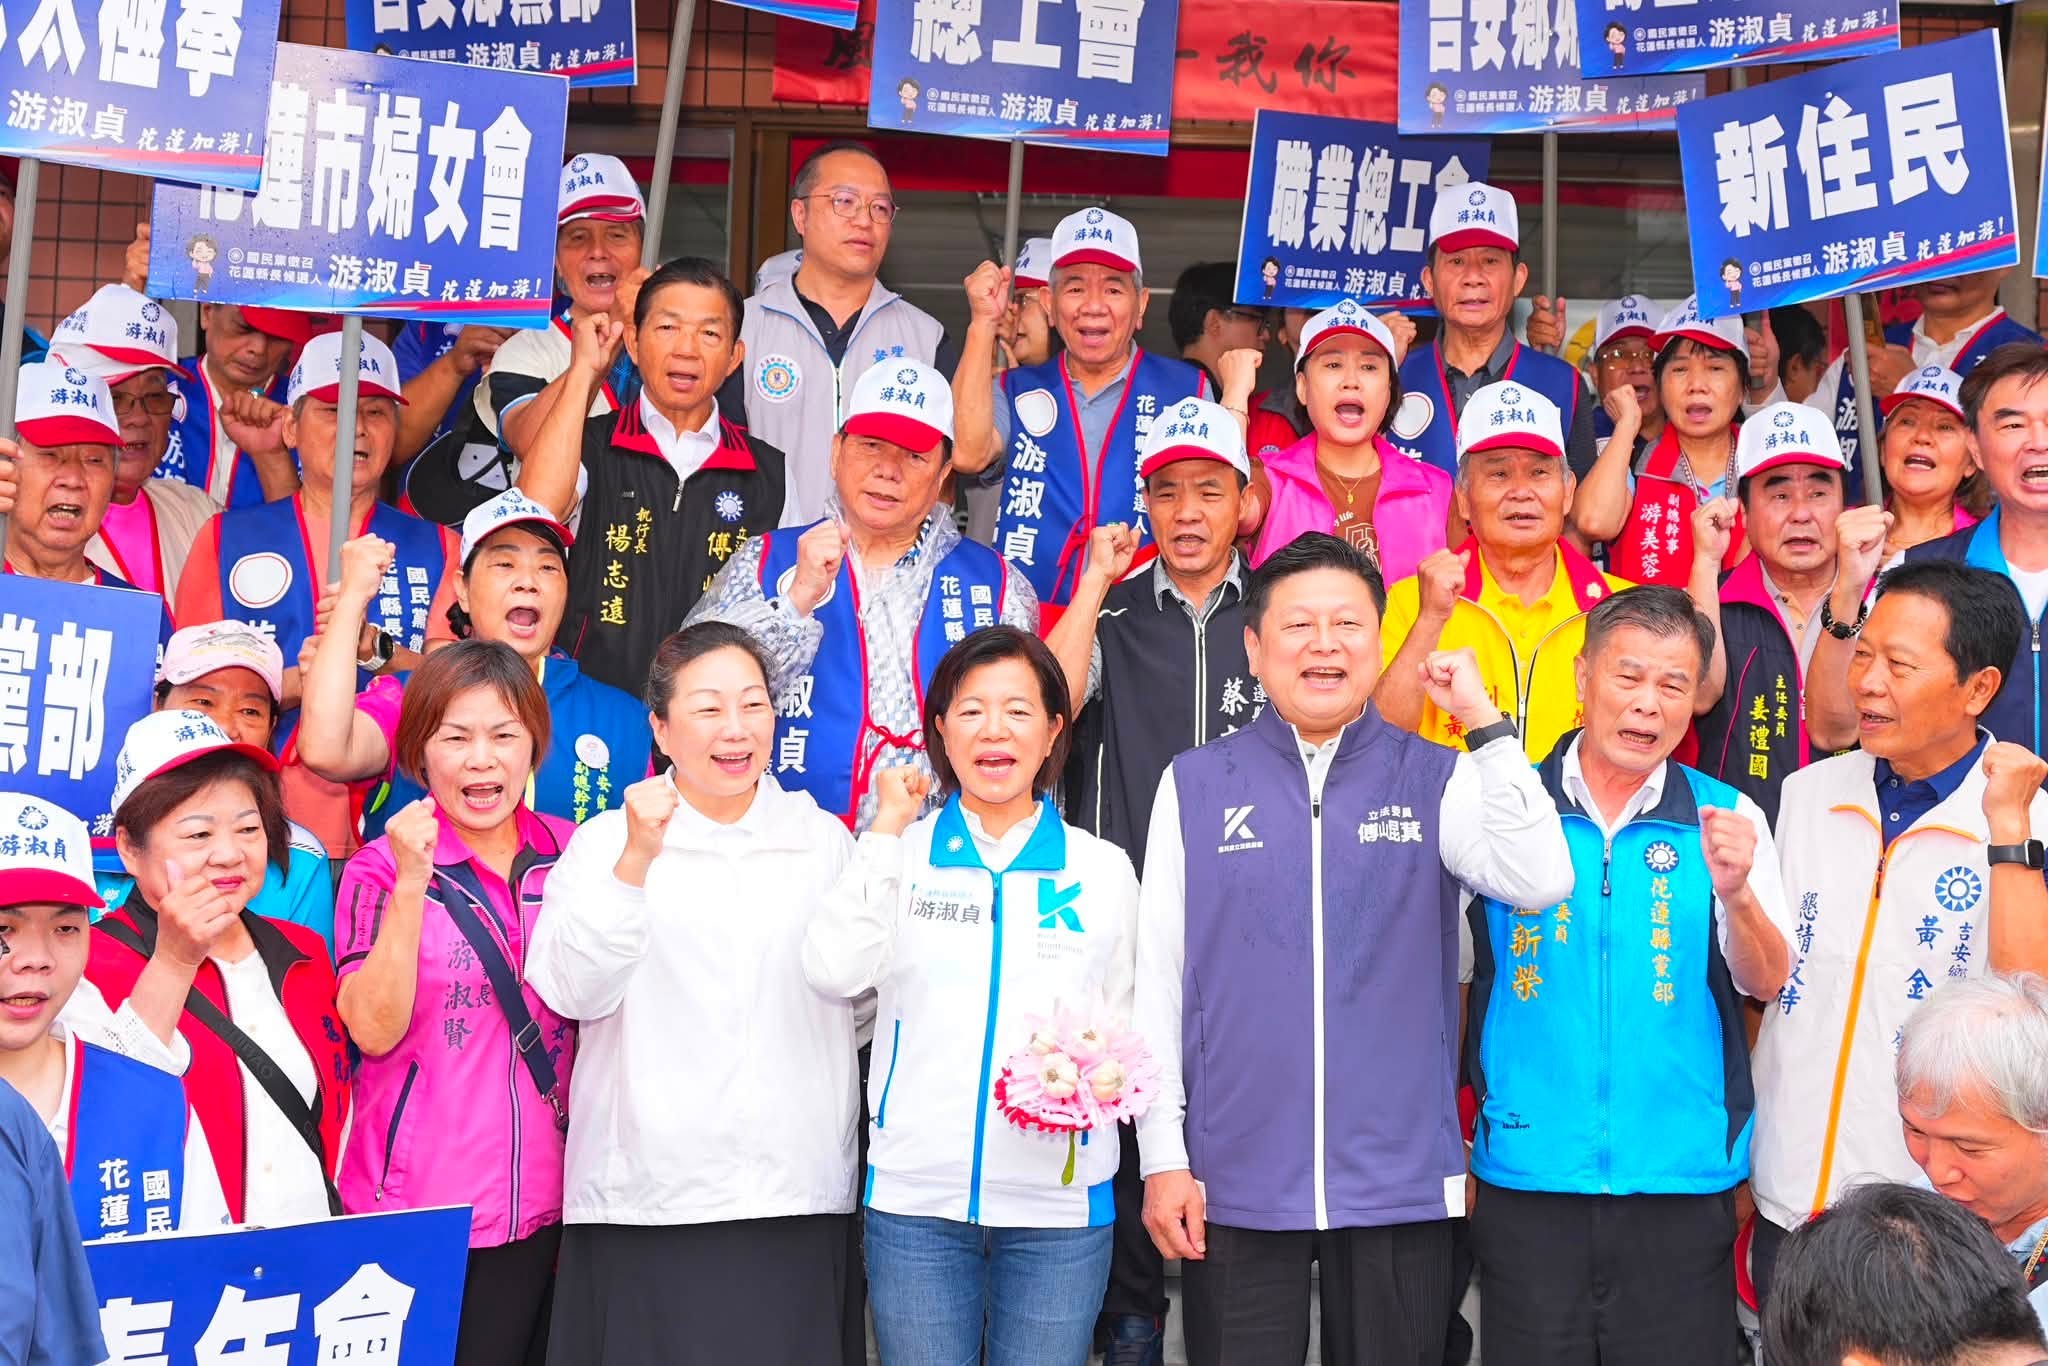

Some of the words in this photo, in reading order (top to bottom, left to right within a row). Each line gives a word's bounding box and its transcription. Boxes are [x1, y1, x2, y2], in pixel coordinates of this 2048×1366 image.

[1708, 13, 1793, 49] 游淑貞
[465, 41, 541, 69] 游淑貞
[6, 88, 128, 144] 游淑貞
[1000, 92, 1080, 127] 游淑貞
[1528, 84, 1608, 113] 游淑貞
[1713, 72, 1970, 238] 新住民
[328, 254, 432, 297] 游淑貞
[1822, 231, 1908, 275] 游淑貞
[1343, 267, 1406, 297] 游淑貞
[1003, 432, 1047, 567] 游淑貞
[633, 506, 653, 554] 執行長
[1640, 502, 1662, 579] 游美蓉
[600, 523, 633, 625] 楊志遠
[1749, 694, 1770, 780] 姜禮國
[914, 897, 981, 925] 游淑貞
[443, 940, 475, 1050] 游淑賢
